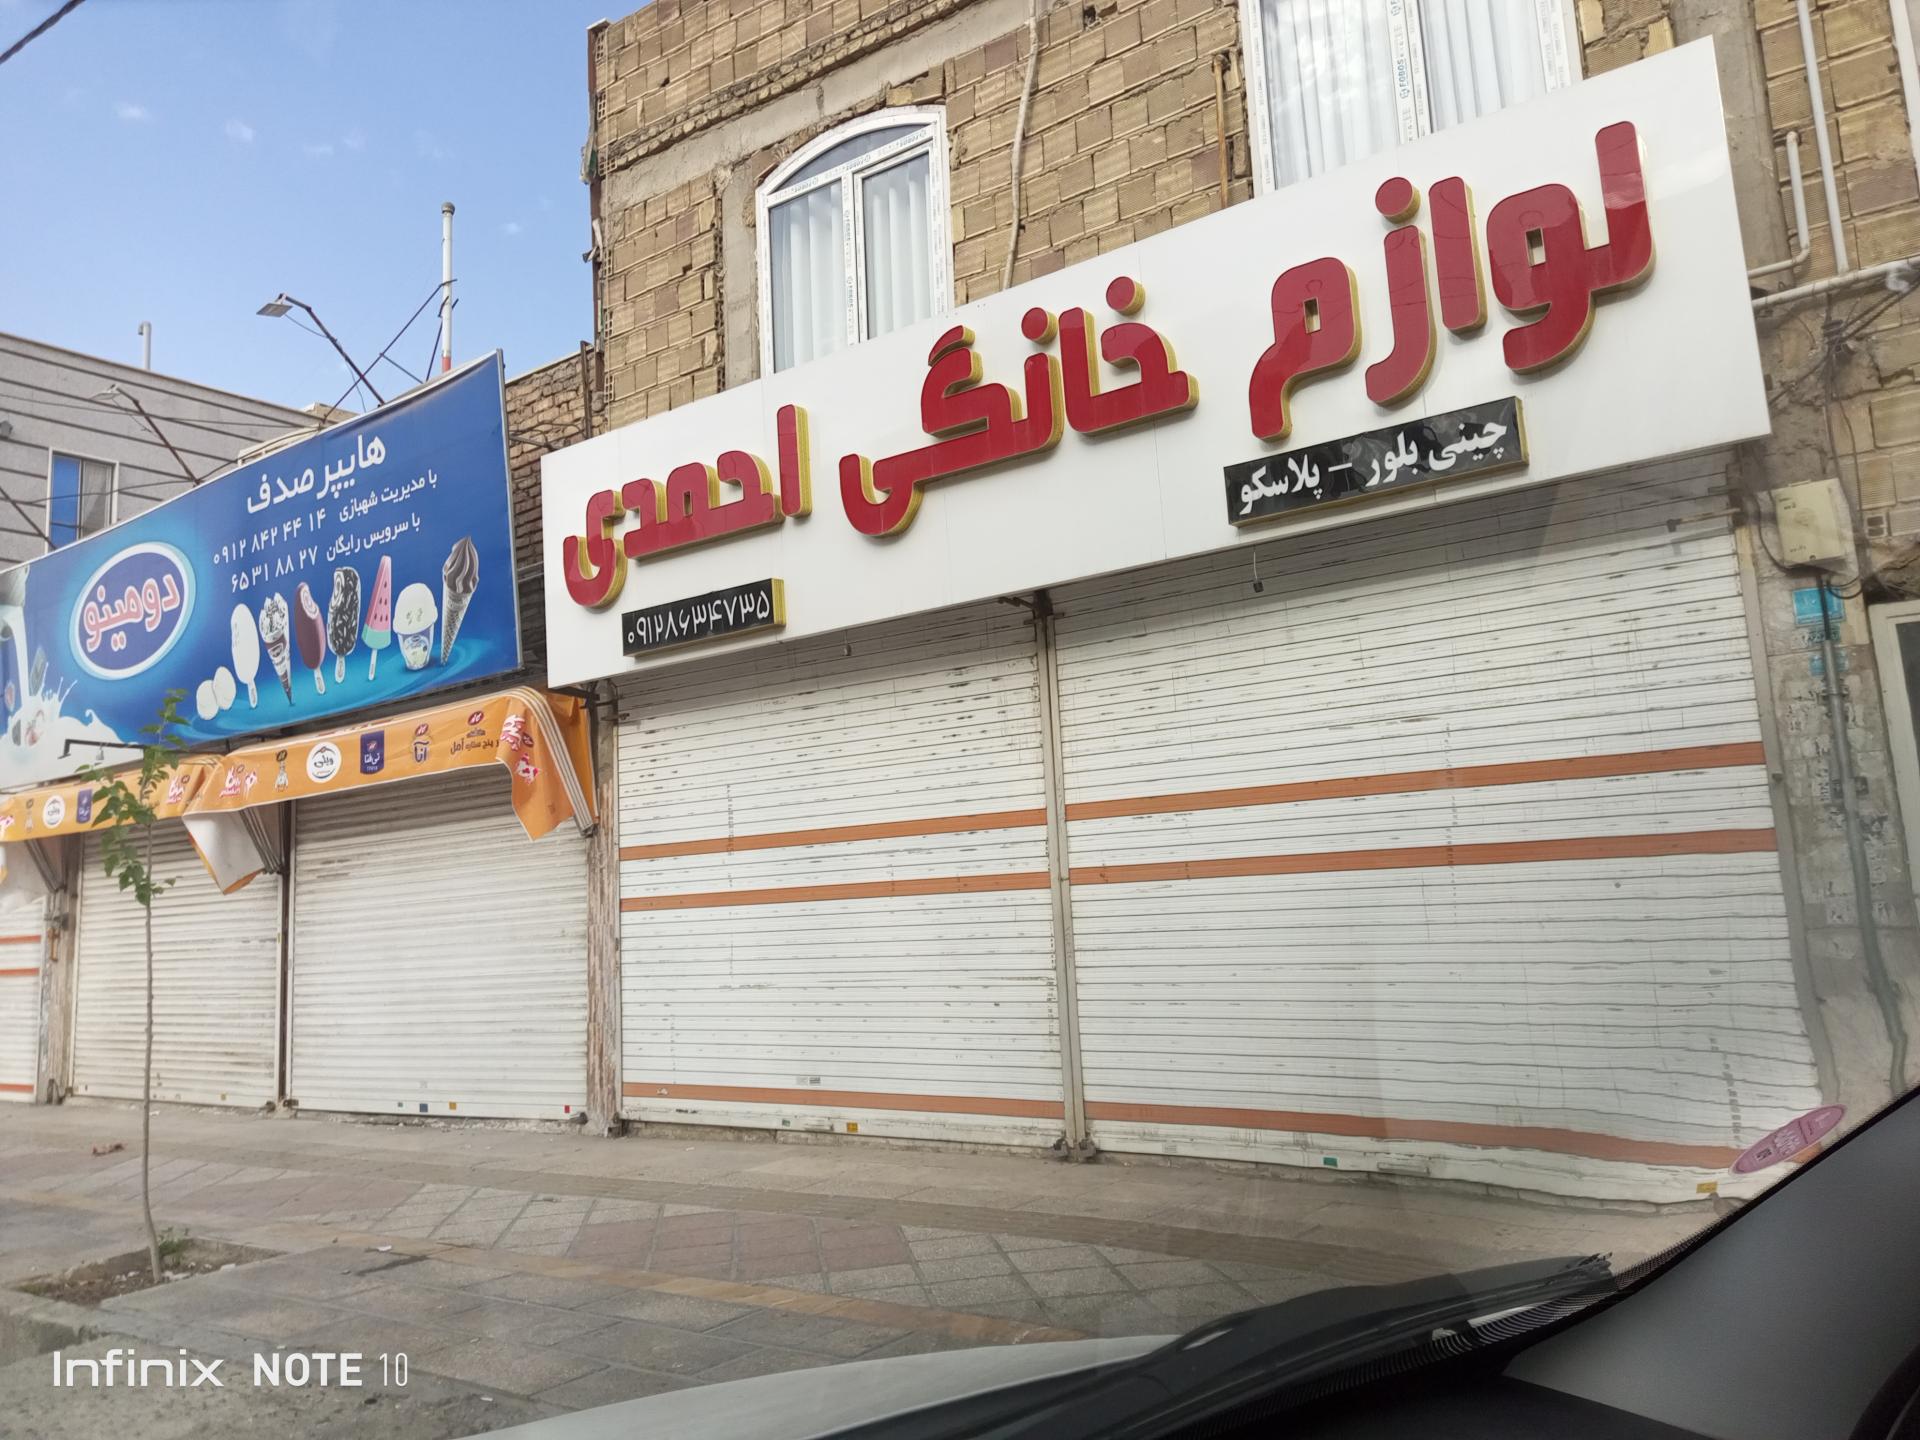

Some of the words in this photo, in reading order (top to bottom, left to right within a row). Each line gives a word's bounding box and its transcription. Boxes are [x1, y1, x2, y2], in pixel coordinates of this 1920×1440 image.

[1249, 121, 1655, 441] لوازم
[839, 276, 1198, 537] خانگی
[316, 434, 386, 500] هایپر
[1365, 431, 1419, 487] بلور
[1428, 421, 1508, 471] چینی
[247, 468, 315, 514] صدف
[381, 476, 426, 502] مدیریت
[428, 469, 438, 488] با
[1239, 454, 1323, 515] پلاسکو
[339, 491, 378, 523] شهبازی
[411, 512, 421, 532] با
[563, 404, 812, 607] احمدی
[213, 539, 247, 566] ۰۹۱۲
[251, 529, 278, 553] ۸۴۲
[283, 517, 302, 541] ۴۴
[309, 508, 326, 532] ۱۴
[326, 535, 361, 562] رایگان
[363, 520, 409, 549] سرویس
[275, 555, 294, 578] ۸۸
[300, 545, 318, 570] ۲۷
[81, 572, 181, 653] دومینو
[627, 590, 770, 645] ۰۹۱۲۸۶۳۴۷۳۵
